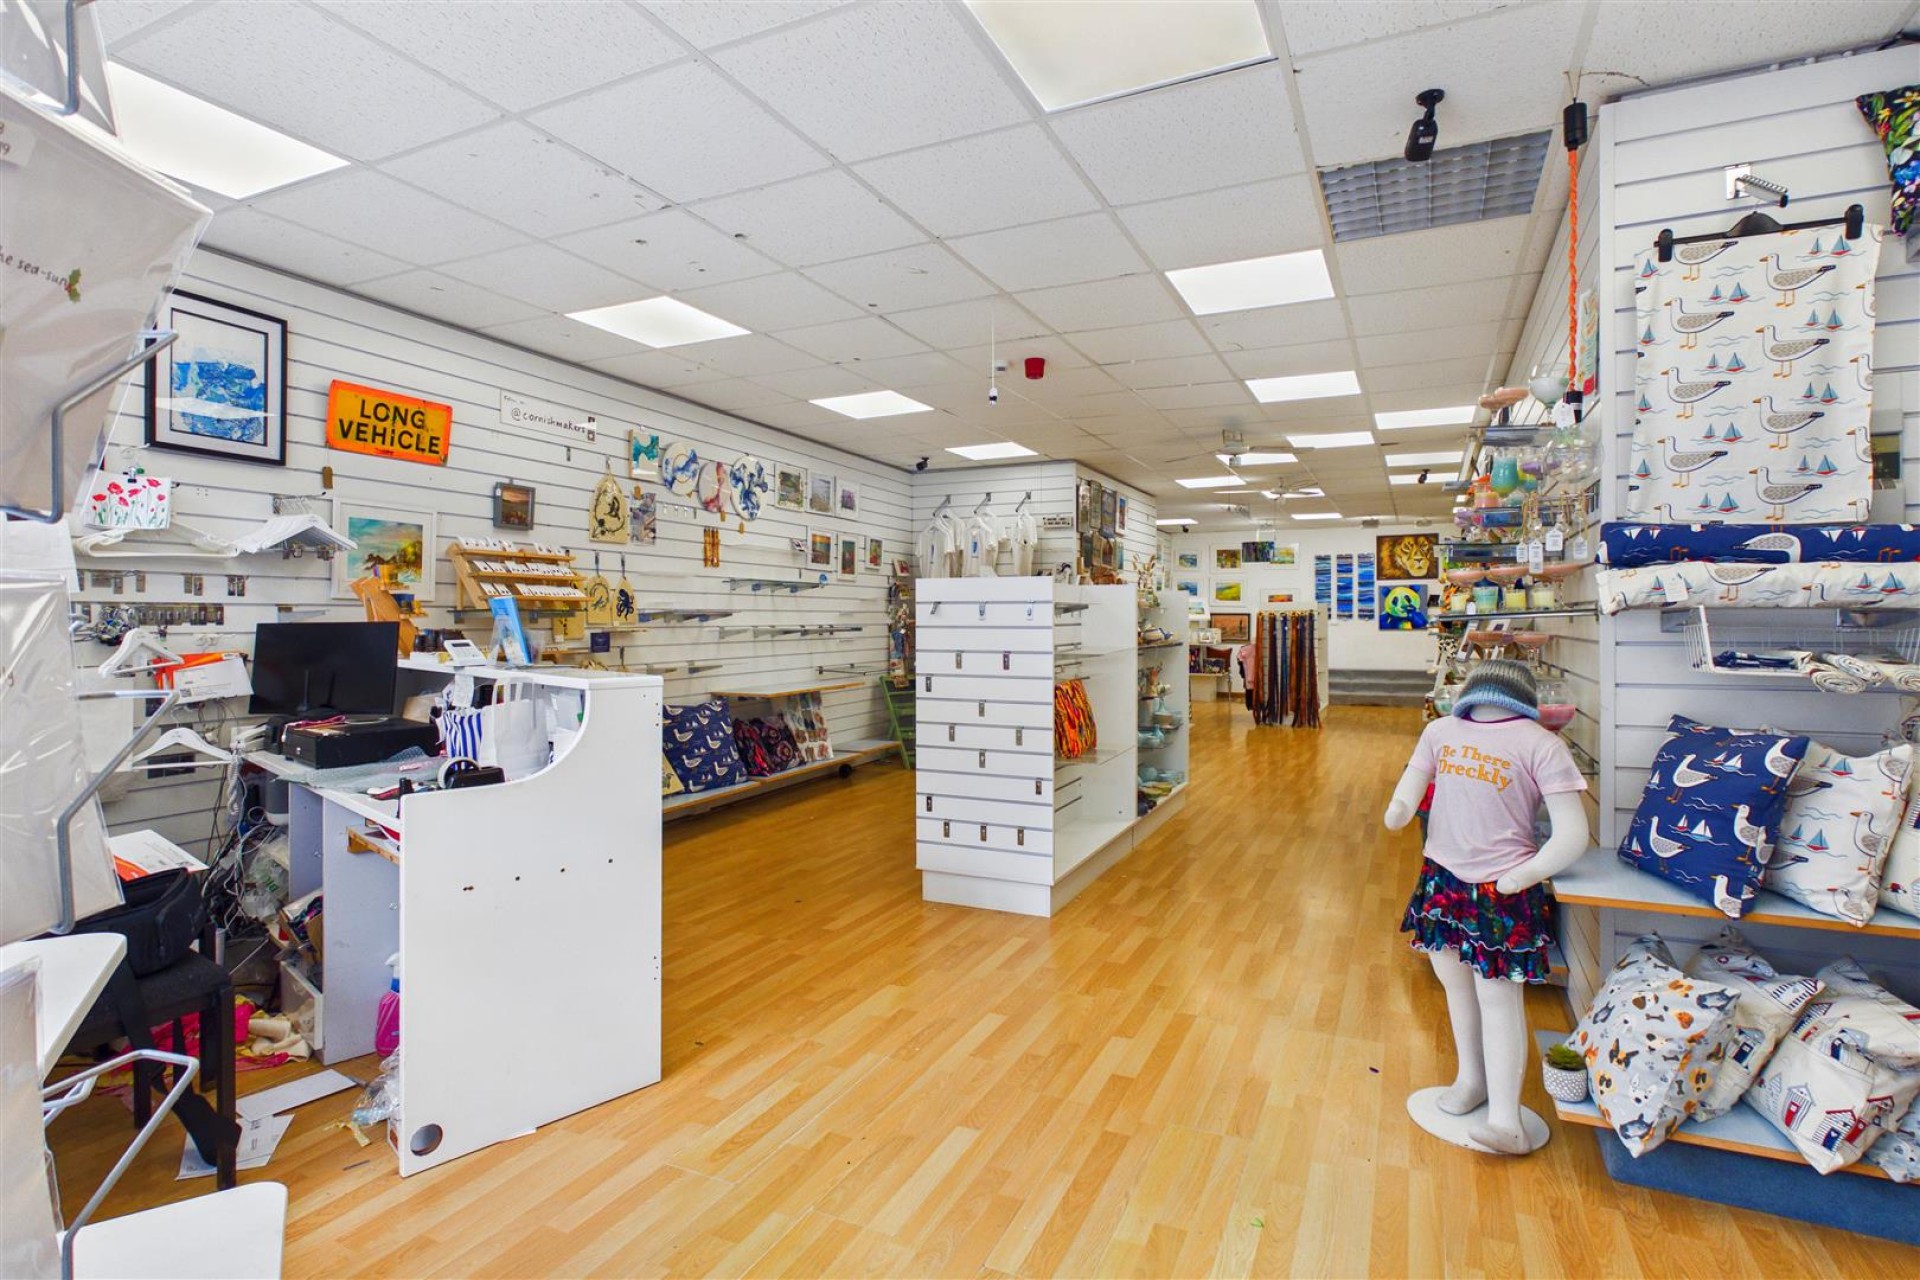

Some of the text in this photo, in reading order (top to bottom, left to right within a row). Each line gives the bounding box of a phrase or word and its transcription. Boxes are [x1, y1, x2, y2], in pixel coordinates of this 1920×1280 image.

[360, 399, 425, 430] LONG
[338, 418, 440, 455] VEHICLE
[1442, 744, 1511, 769] Be There
[1438, 758, 1513, 793] Dreckly
